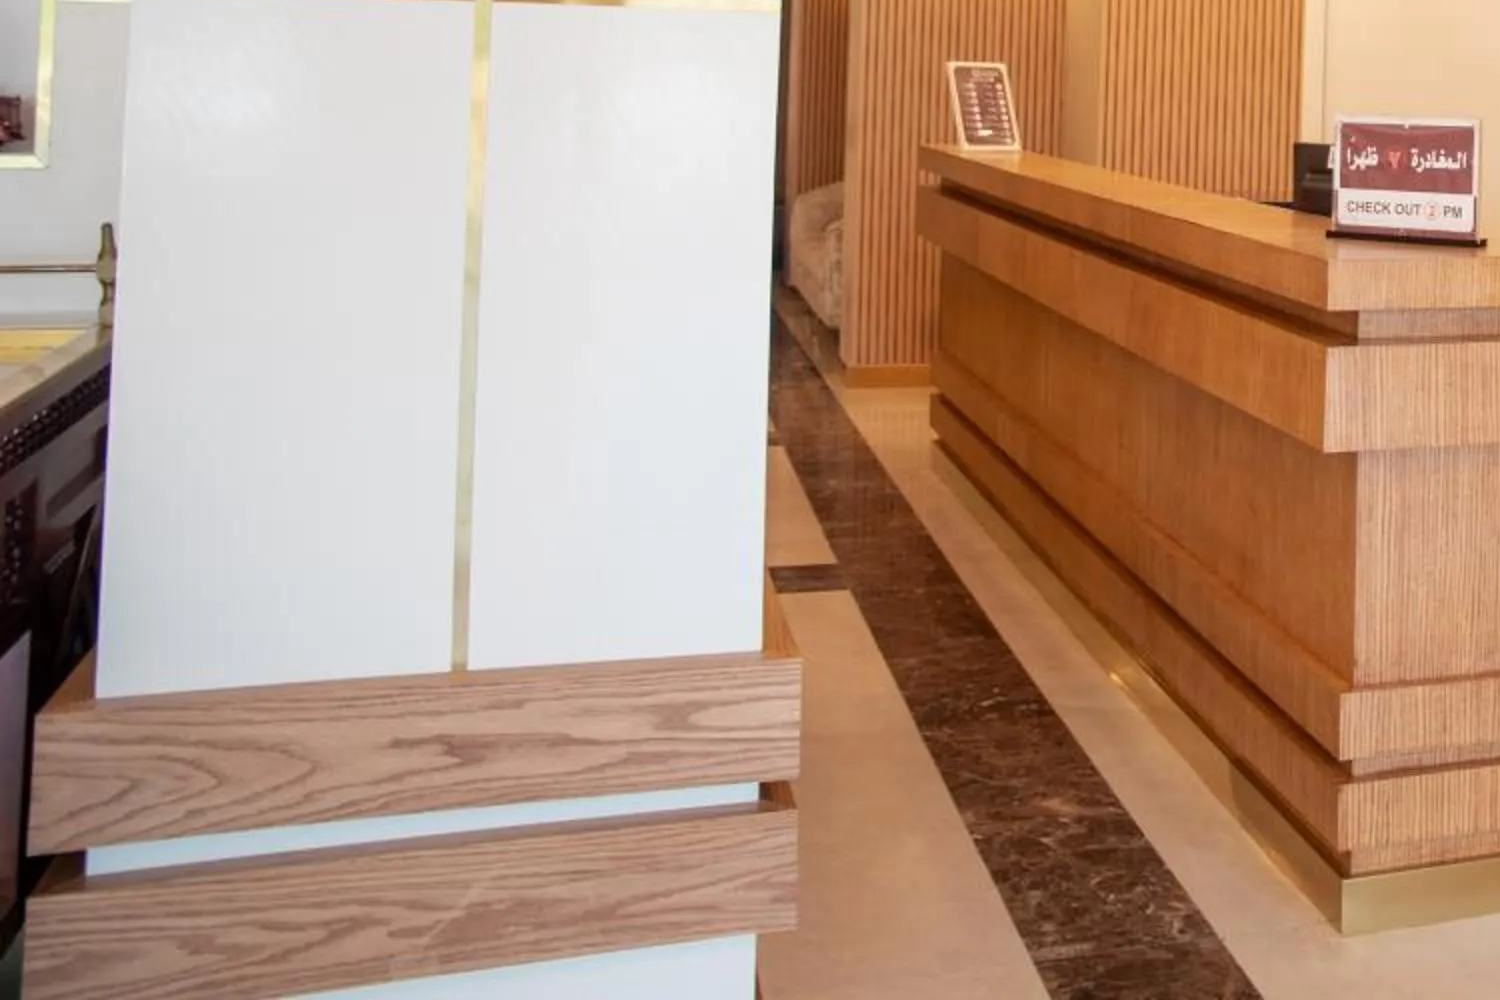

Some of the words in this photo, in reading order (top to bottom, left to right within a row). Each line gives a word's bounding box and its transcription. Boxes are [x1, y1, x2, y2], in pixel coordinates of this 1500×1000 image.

[1346, 200, 1391, 215] CHECK
[1394, 203, 1422, 216] OUT
[1443, 205, 1463, 218] PM
